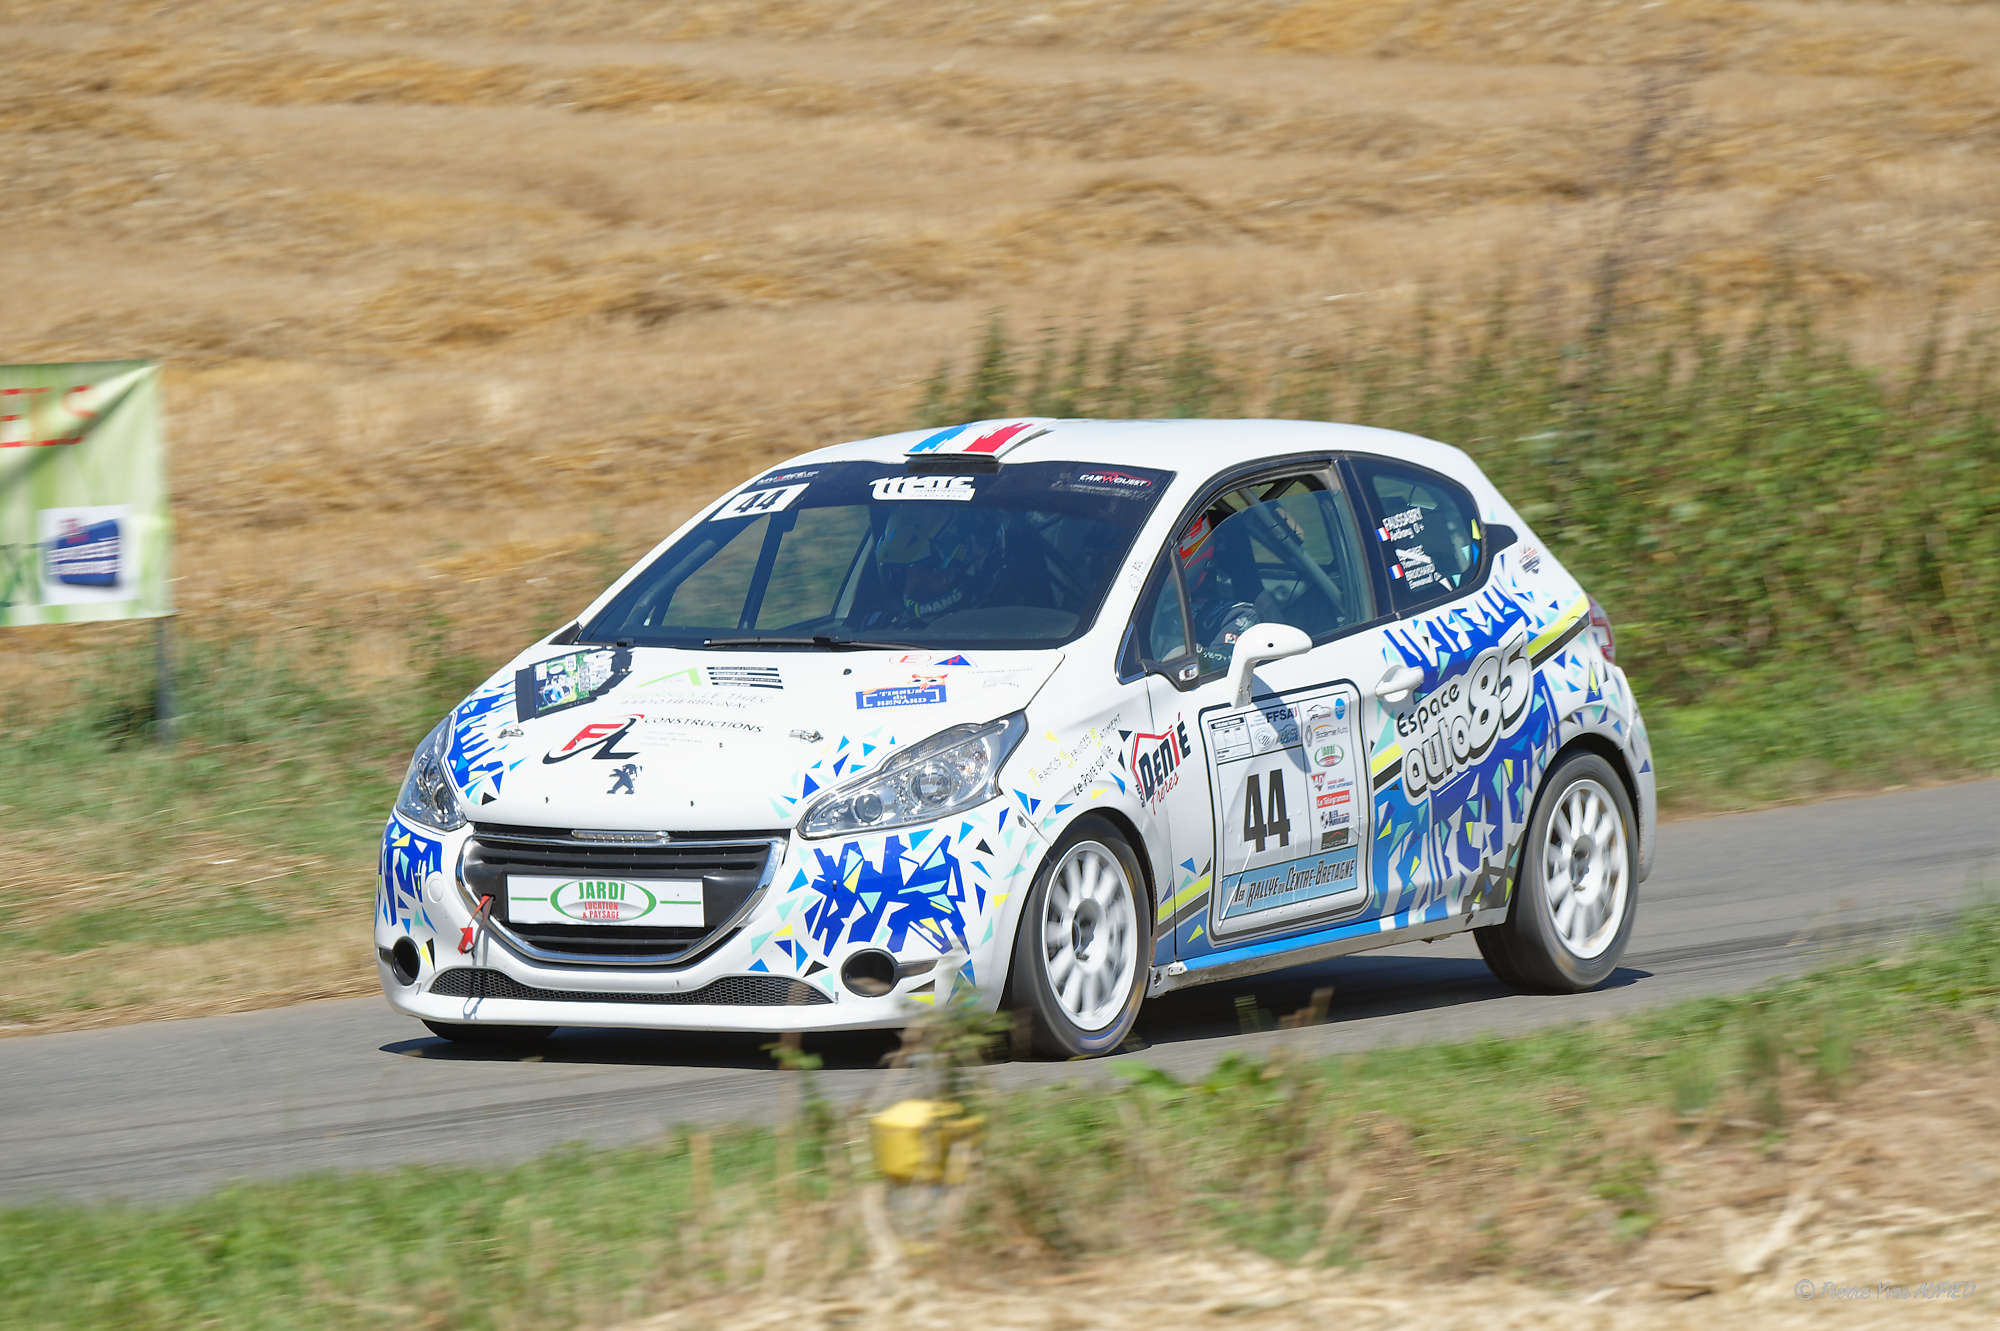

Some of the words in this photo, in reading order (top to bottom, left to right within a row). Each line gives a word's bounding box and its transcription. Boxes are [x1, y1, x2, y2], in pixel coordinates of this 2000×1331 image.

[734, 488, 788, 513] 44
[1266, 708, 1295, 723] FFSA
[1397, 683, 1460, 737] Espace
[644, 716, 764, 733] CONSTRUCTIONS
[1243, 768, 1291, 852] 44
[578, 881, 626, 901] JARDI
[1246, 876, 1280, 908] RALLYE
[1285, 860, 1355, 894] CENTRE-BRETAGNE
[582, 912, 588, 920] &
[589, 911, 620, 920] PAYSAGE
[584, 901, 619, 911] LOCATION
